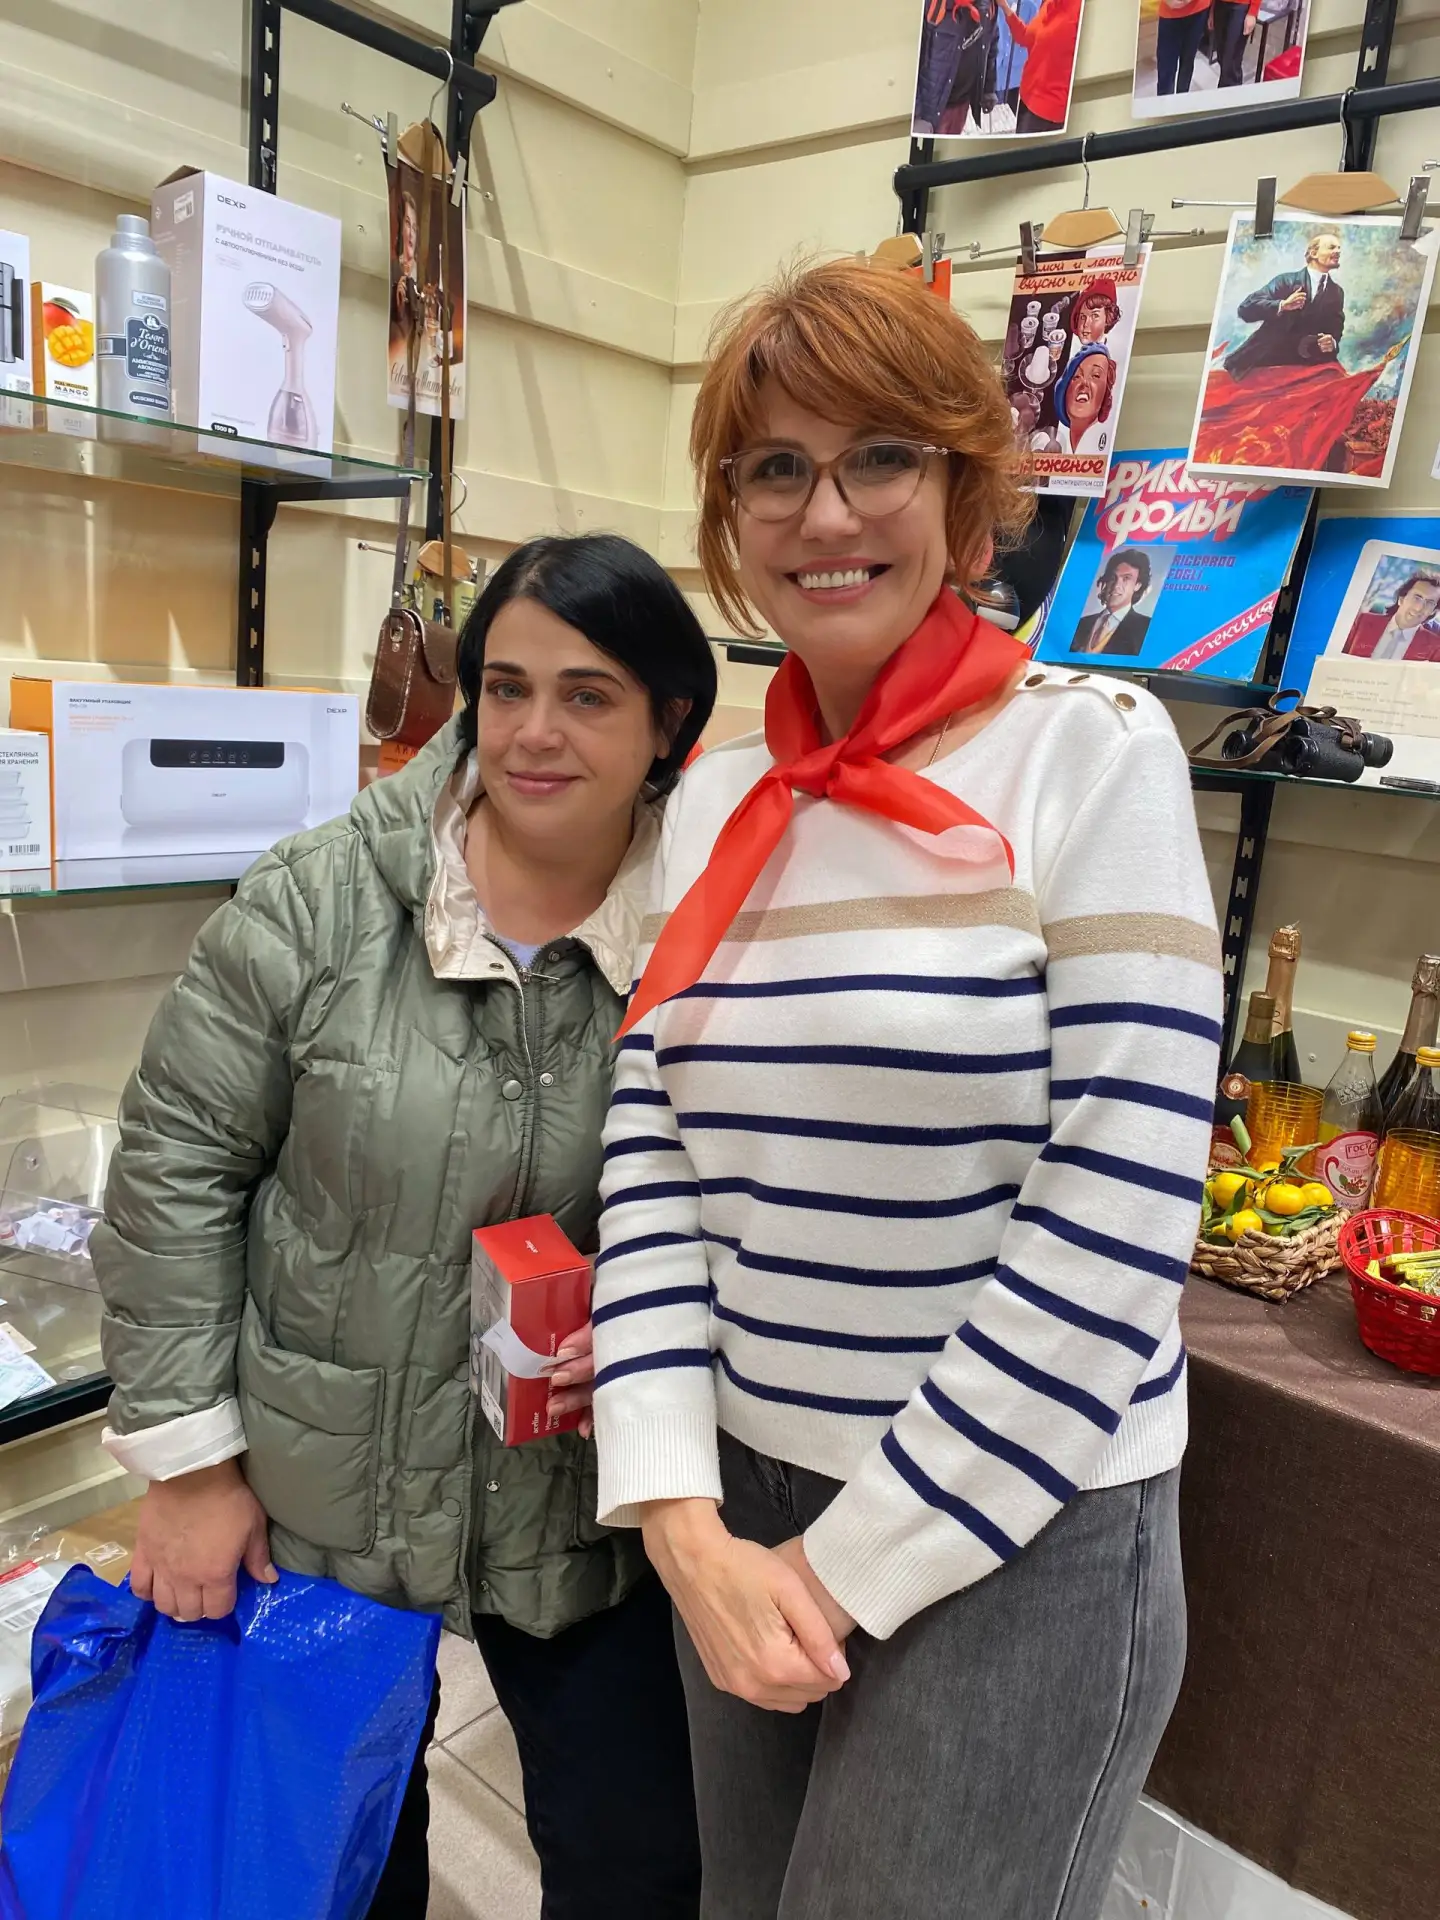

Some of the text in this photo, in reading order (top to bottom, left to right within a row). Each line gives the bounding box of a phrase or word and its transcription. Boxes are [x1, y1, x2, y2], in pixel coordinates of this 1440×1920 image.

[216, 194, 247, 210] DEXP
[215, 223, 253, 243] РУЧНОЙ
[254, 237, 322, 267] ОТПАРИВАТЕЛЬ
[1087, 256, 1125, 268] лето
[1018, 276, 1067, 292] вкусно
[138, 327, 165, 344] Tesori
[54, 385, 89, 397] MANGO
[213, 424, 228, 433] 1500
[1107, 488, 1247, 552] ФОЛЬИ
[1171, 554, 1237, 568] RICCARDO
[1166, 568, 1203, 581] FOGLI
[531, 1411, 540, 1434] aceline
